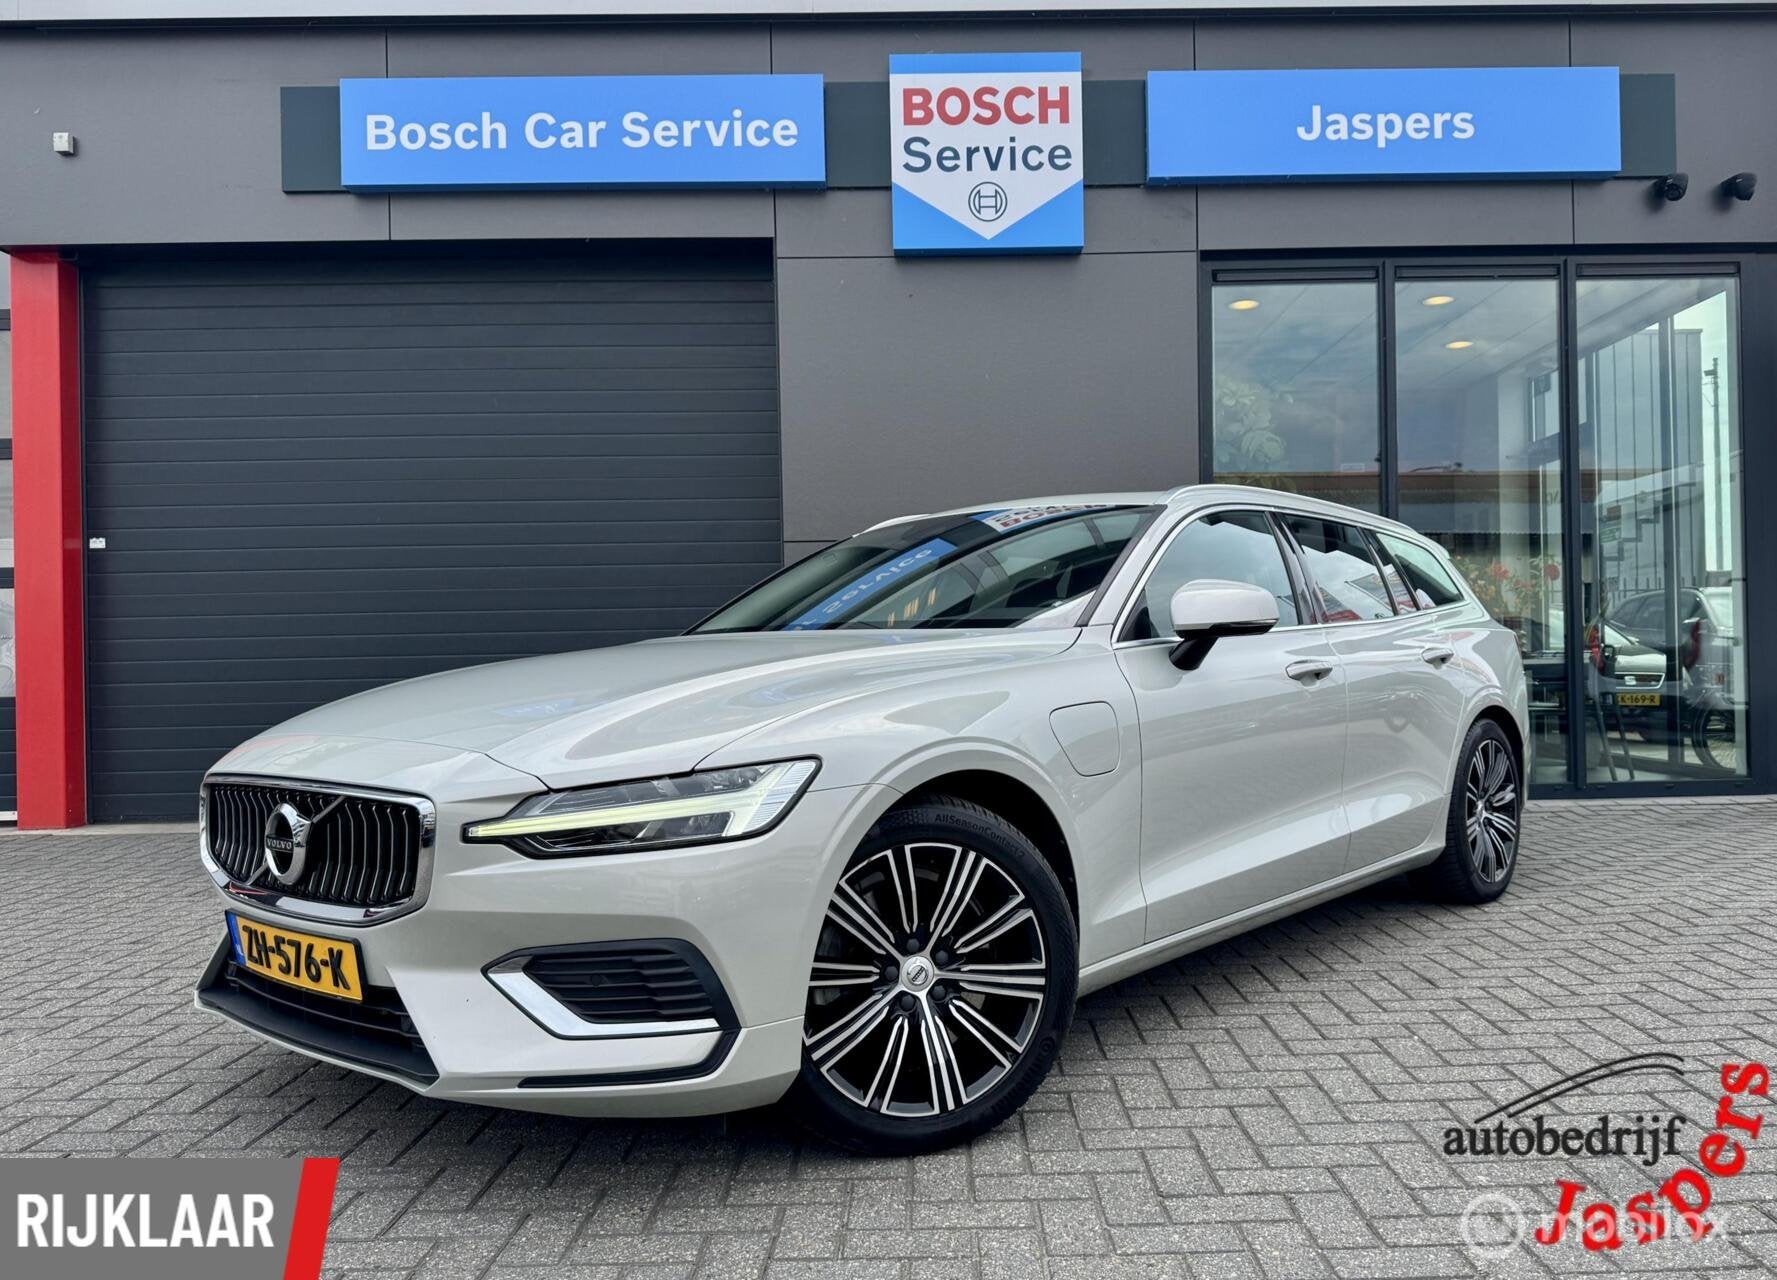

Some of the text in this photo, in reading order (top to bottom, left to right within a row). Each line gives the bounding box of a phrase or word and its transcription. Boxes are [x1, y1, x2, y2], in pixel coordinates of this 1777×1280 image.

[902, 86, 1070, 126] BOSCH
[365, 108, 799, 151] Bosch Car Service
[1296, 104, 1476, 149] Jaspers
[902, 136, 1072, 173] Service
[1616, 693, 1657, 704] K-169-R
[266, 837, 292, 850] VOLVO
